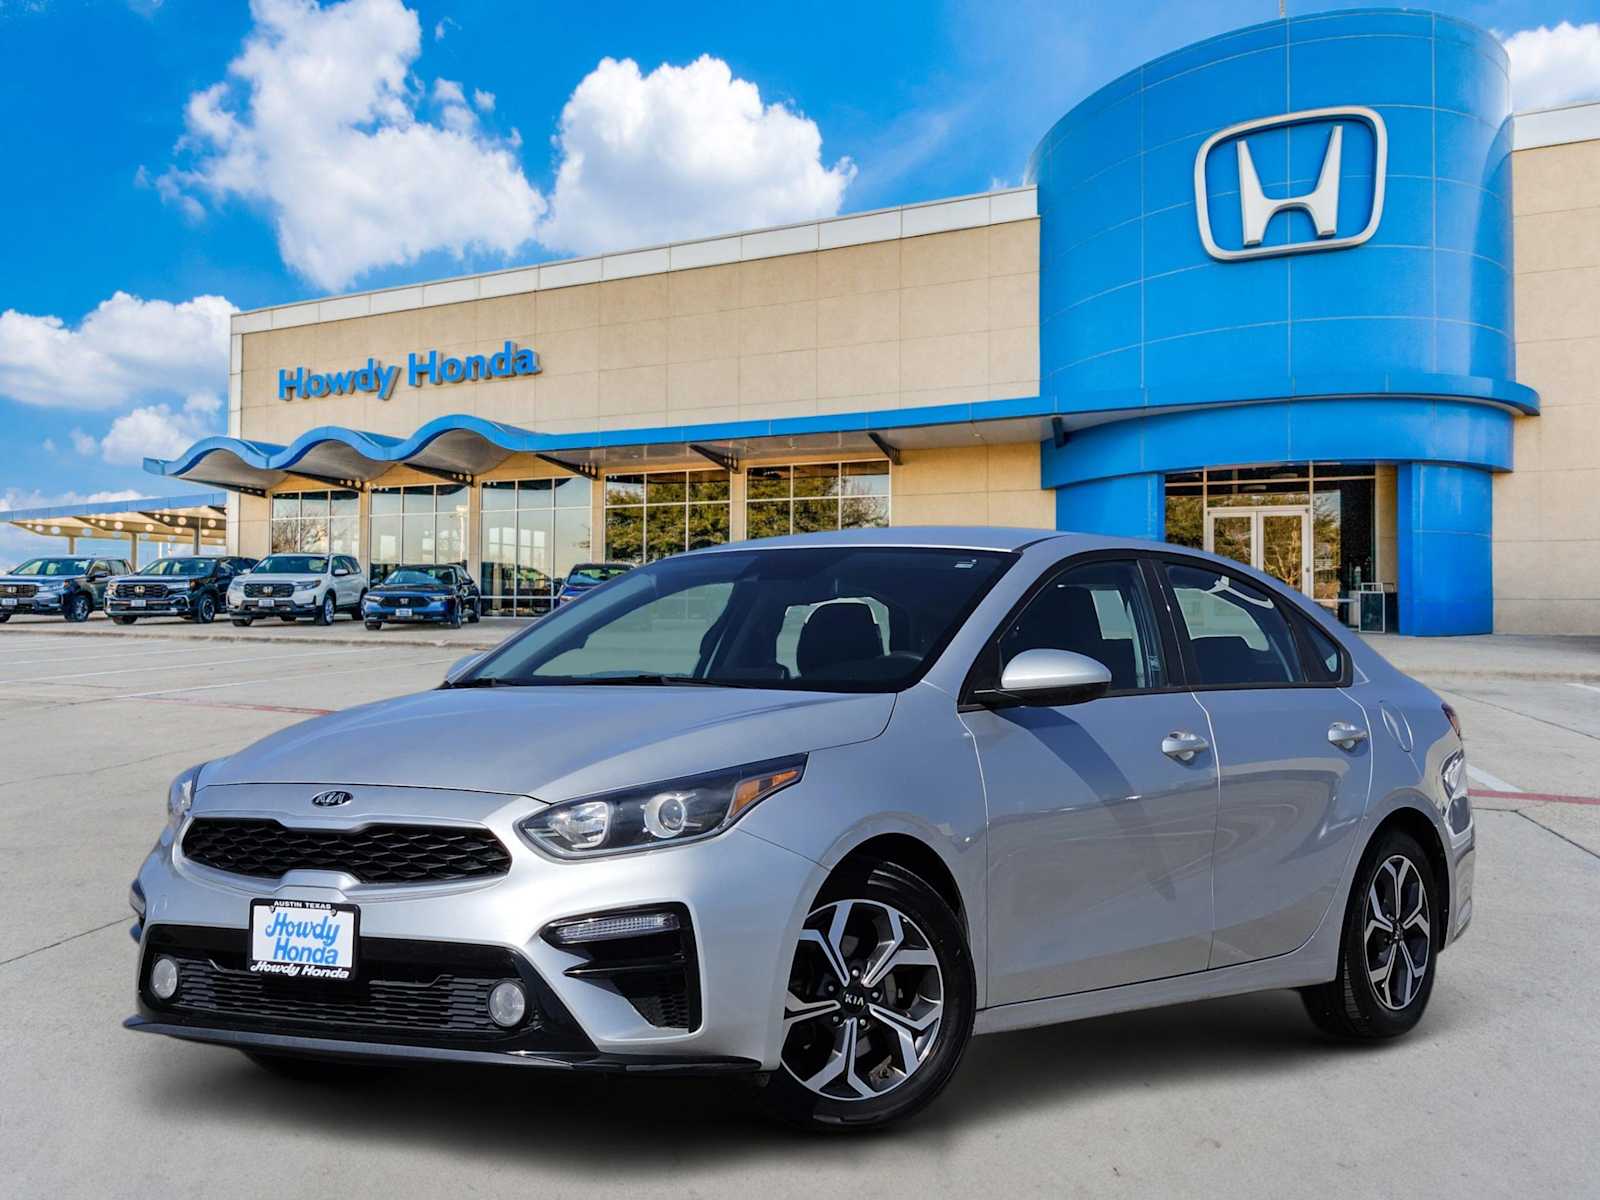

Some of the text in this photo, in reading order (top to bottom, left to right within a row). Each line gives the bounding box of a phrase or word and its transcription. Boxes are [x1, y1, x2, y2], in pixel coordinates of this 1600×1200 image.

[279, 341, 541, 400] Howdy Honda
[273, 900, 332, 910] AUSTIN TEXAS
[265, 912, 341, 946] Howdy
[273, 937, 339, 965] Honda
[250, 960, 350, 979] Howdy Honda
[844, 993, 864, 1006] KIA
